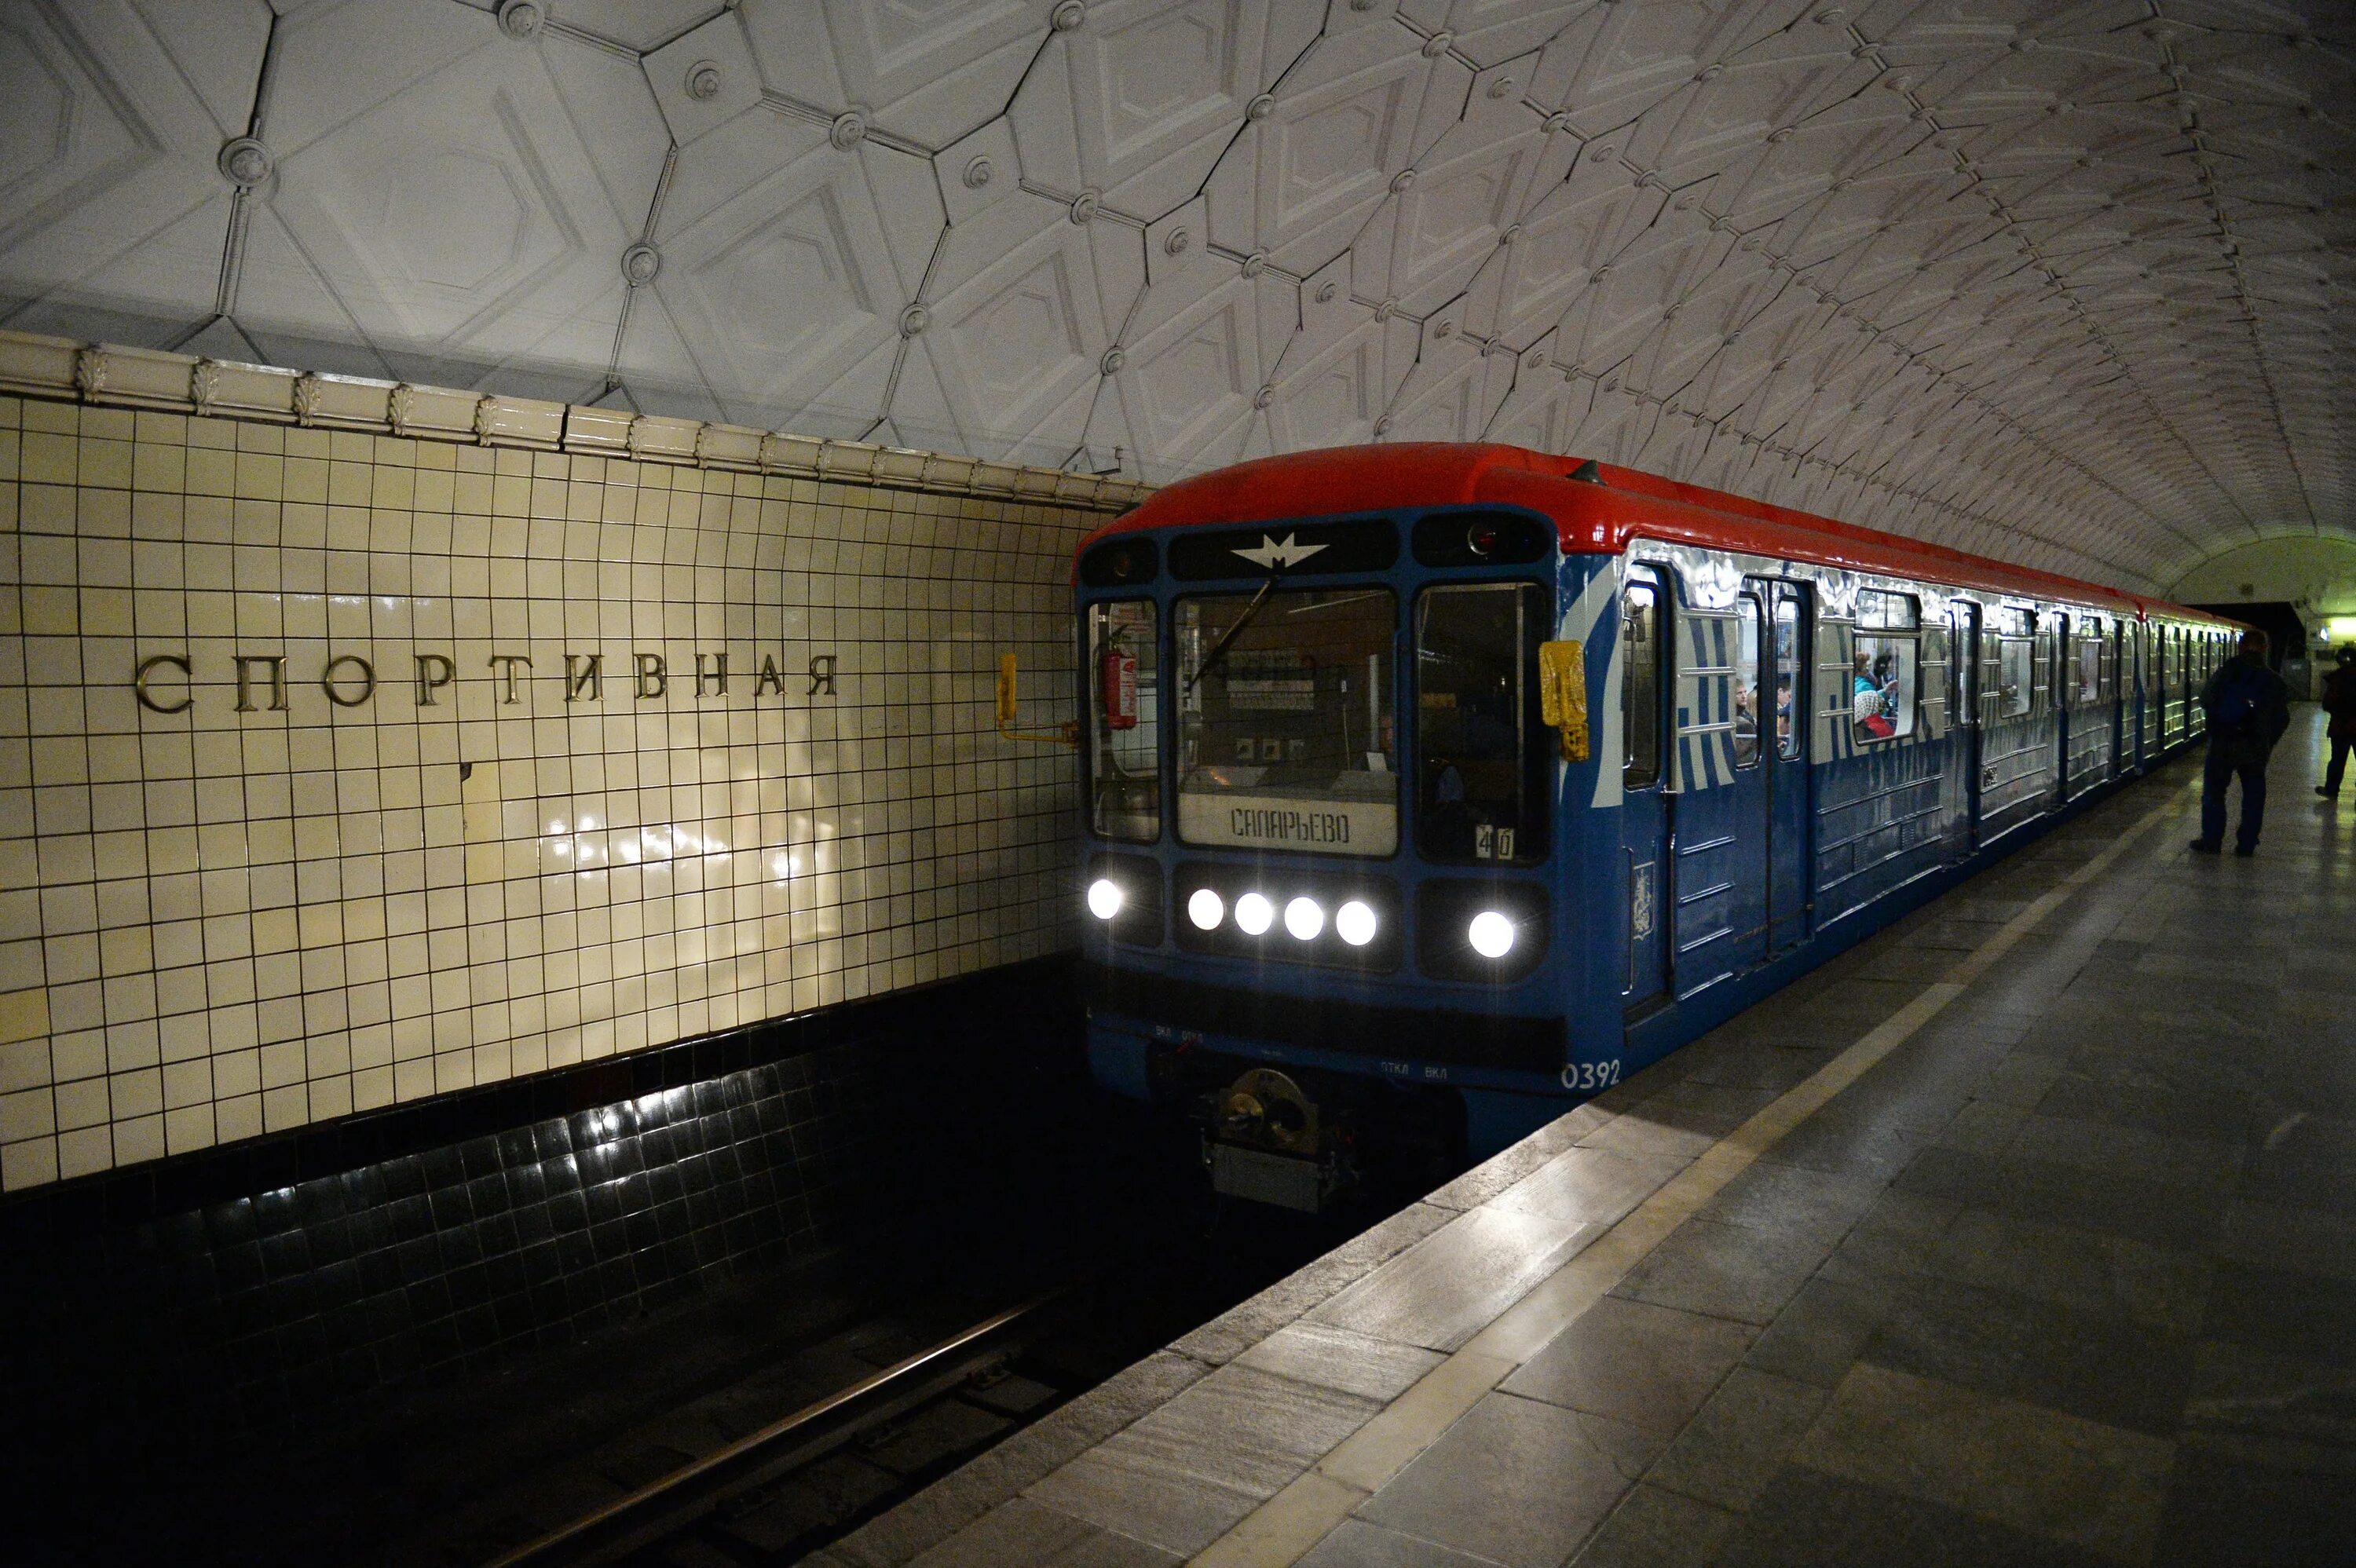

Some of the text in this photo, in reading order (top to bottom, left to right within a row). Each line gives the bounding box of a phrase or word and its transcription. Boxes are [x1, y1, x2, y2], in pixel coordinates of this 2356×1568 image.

[136, 654, 837, 714] СПОРТИВНАЯ
[1231, 808, 1349, 843] САЛАРЬЕВО
[1477, 831, 1510, 856] 40
[1561, 1058, 1620, 1089] 0392
